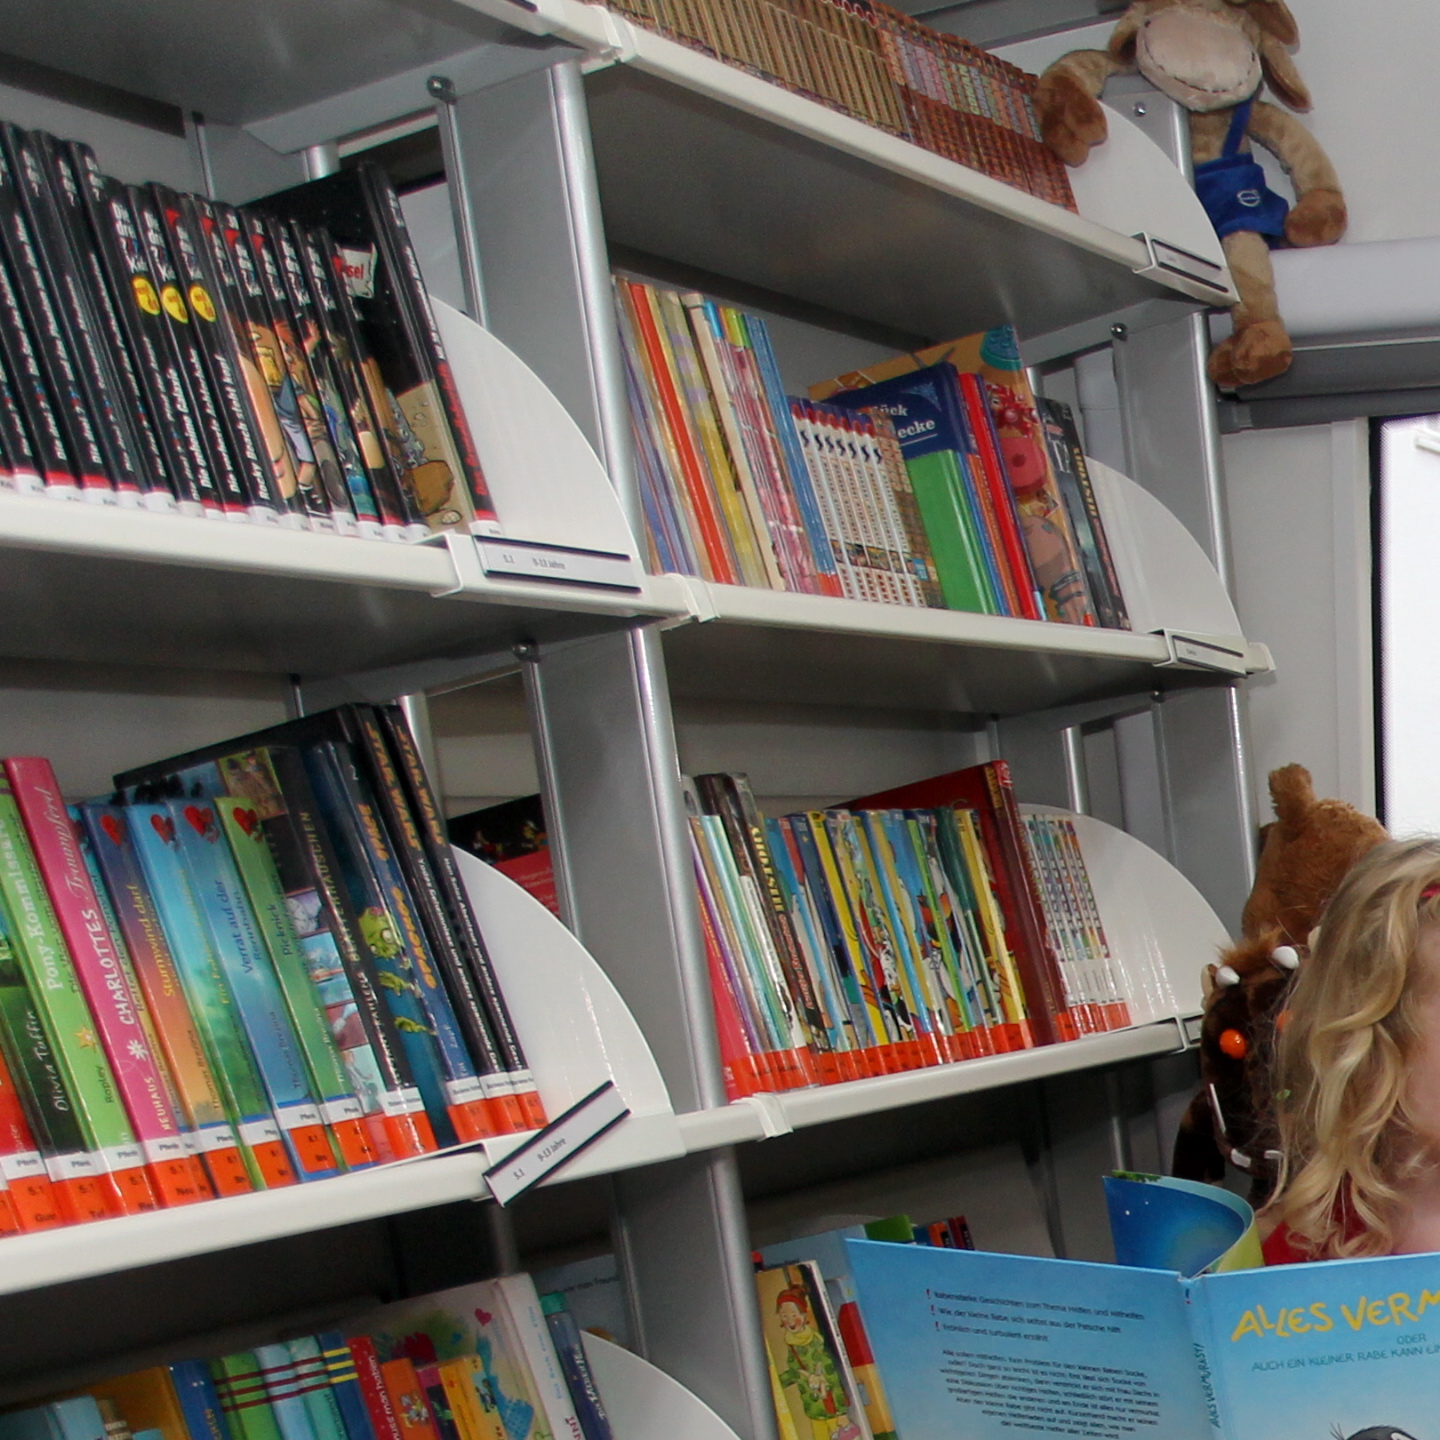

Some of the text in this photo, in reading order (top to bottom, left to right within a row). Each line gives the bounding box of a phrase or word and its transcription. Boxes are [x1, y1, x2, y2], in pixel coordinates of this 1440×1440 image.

[236, 414, 257, 460] Beach
[251, 456, 270, 500] Rocky
[365, 721, 422, 851] STAR WARS
[396, 725, 447, 848] STAR WARS
[128, 884, 175, 998] Sturmwind darf
[269, 903, 294, 957] Picknick
[82, 908, 136, 1025] CHARLOTTES
[232, 934, 253, 974] Verrat
[45, 1064, 69, 1113] Olivia
[144, 1076, 173, 1132] NEUHAUS
[1230, 1302, 1335, 1343] ALLES
[1396, 1333, 1428, 1345] ODER
[368, 1354, 386, 1389] haben
[1251, 1359, 1285, 1373] AUCH
[1286, 1358, 1306, 1370] EIN
[1308, 1353, 1355, 1368] KLEINER
[1357, 1348, 1389, 1361] RABE
[1390, 1344, 1425, 1359] KANN
[377, 1386, 393, 1416] man
